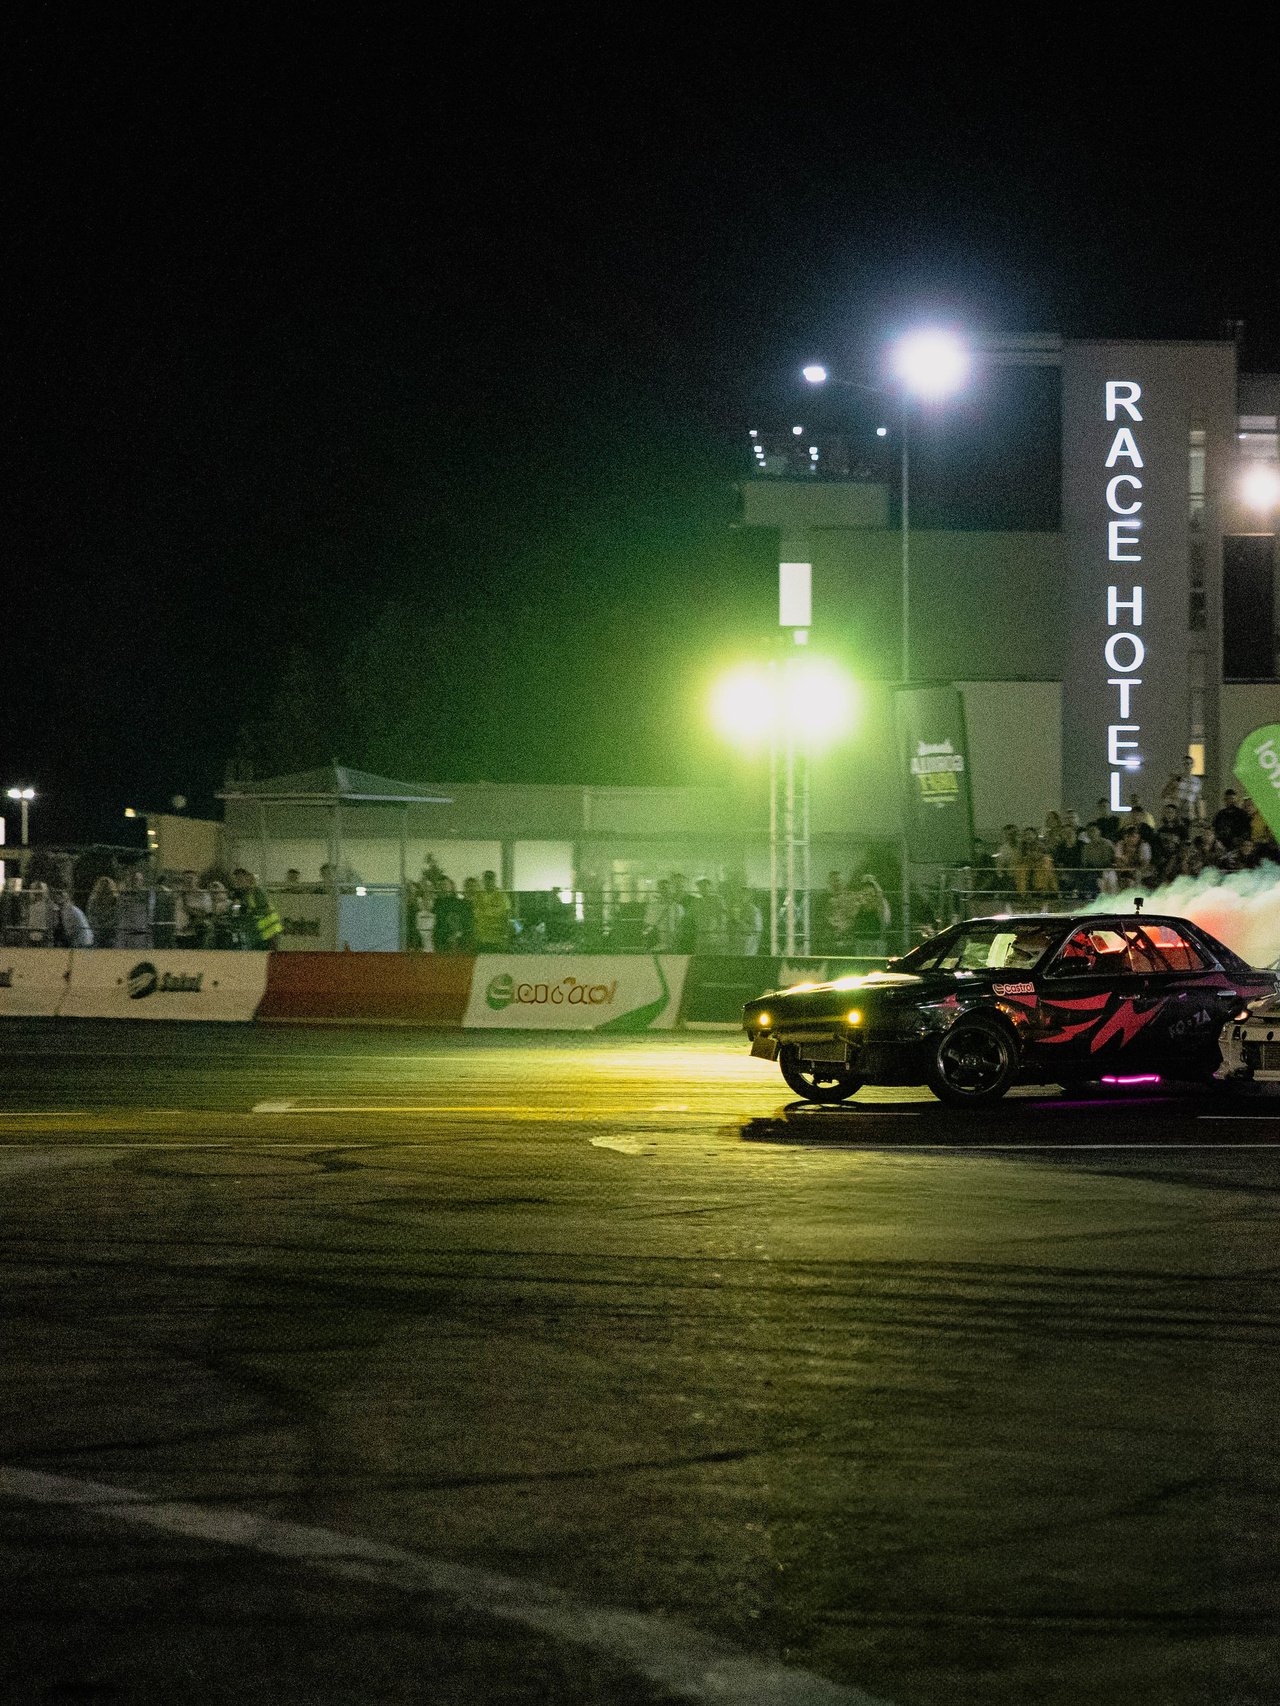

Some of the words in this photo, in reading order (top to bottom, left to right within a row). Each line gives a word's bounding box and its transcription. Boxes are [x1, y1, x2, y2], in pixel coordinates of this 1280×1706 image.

[1104, 380, 1144, 562] RACE
[1104, 586, 1145, 812] HOTEL
[1005, 983, 1034, 993] Castrol
